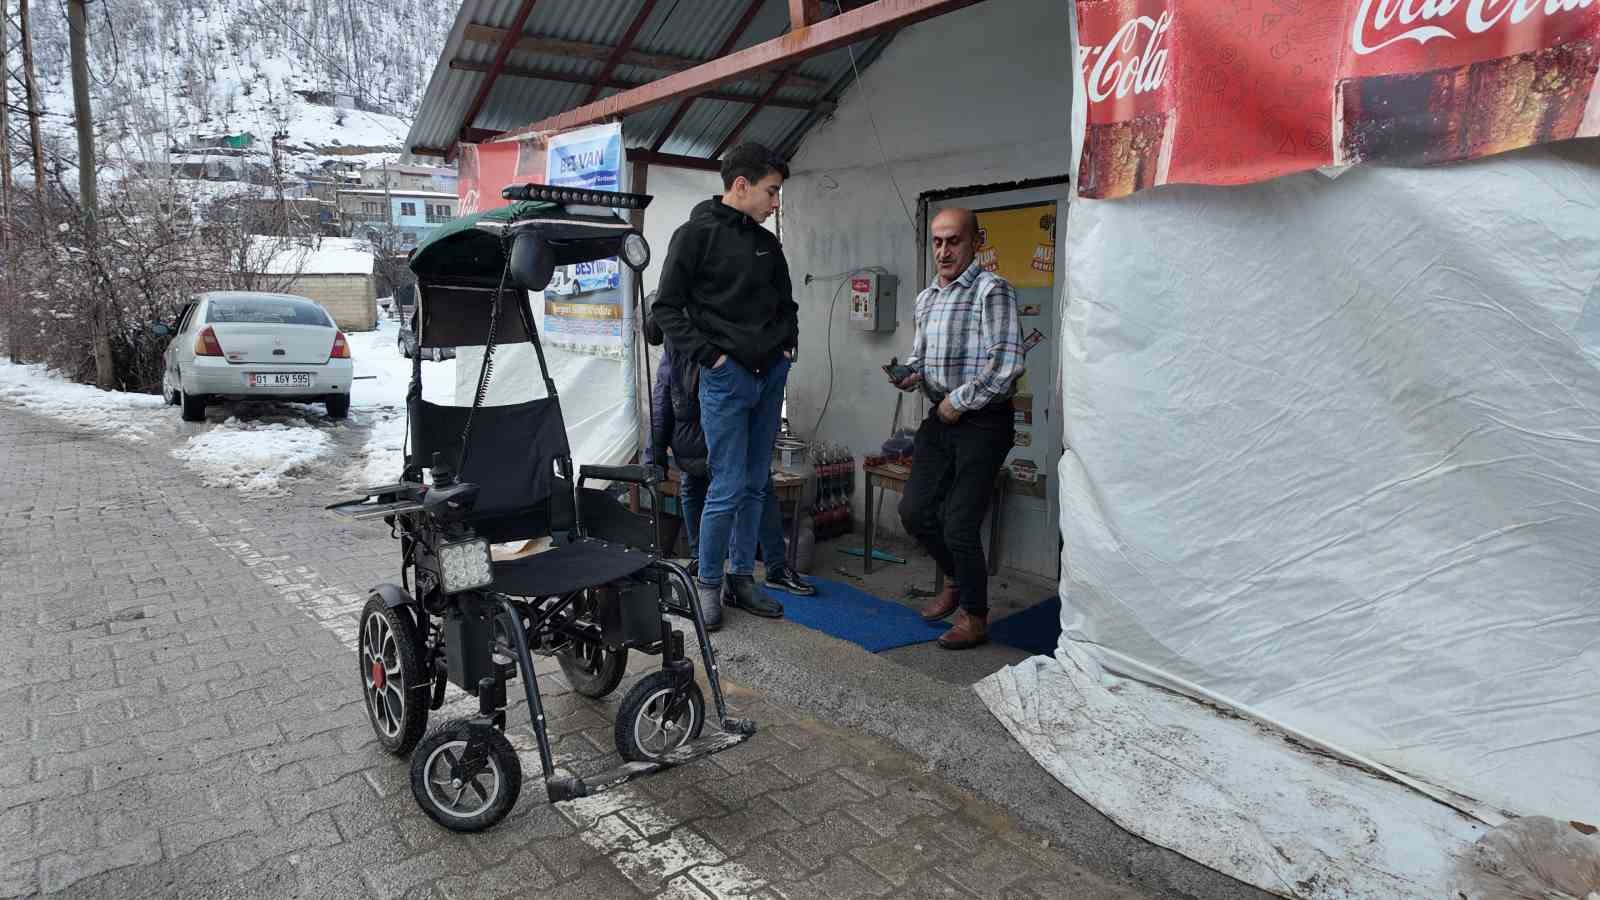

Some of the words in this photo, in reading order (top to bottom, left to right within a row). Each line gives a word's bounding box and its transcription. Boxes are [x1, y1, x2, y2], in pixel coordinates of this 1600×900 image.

[256, 375, 267, 384] 01
[275, 375, 290, 384] AGY
[292, 374, 308, 383] 595
